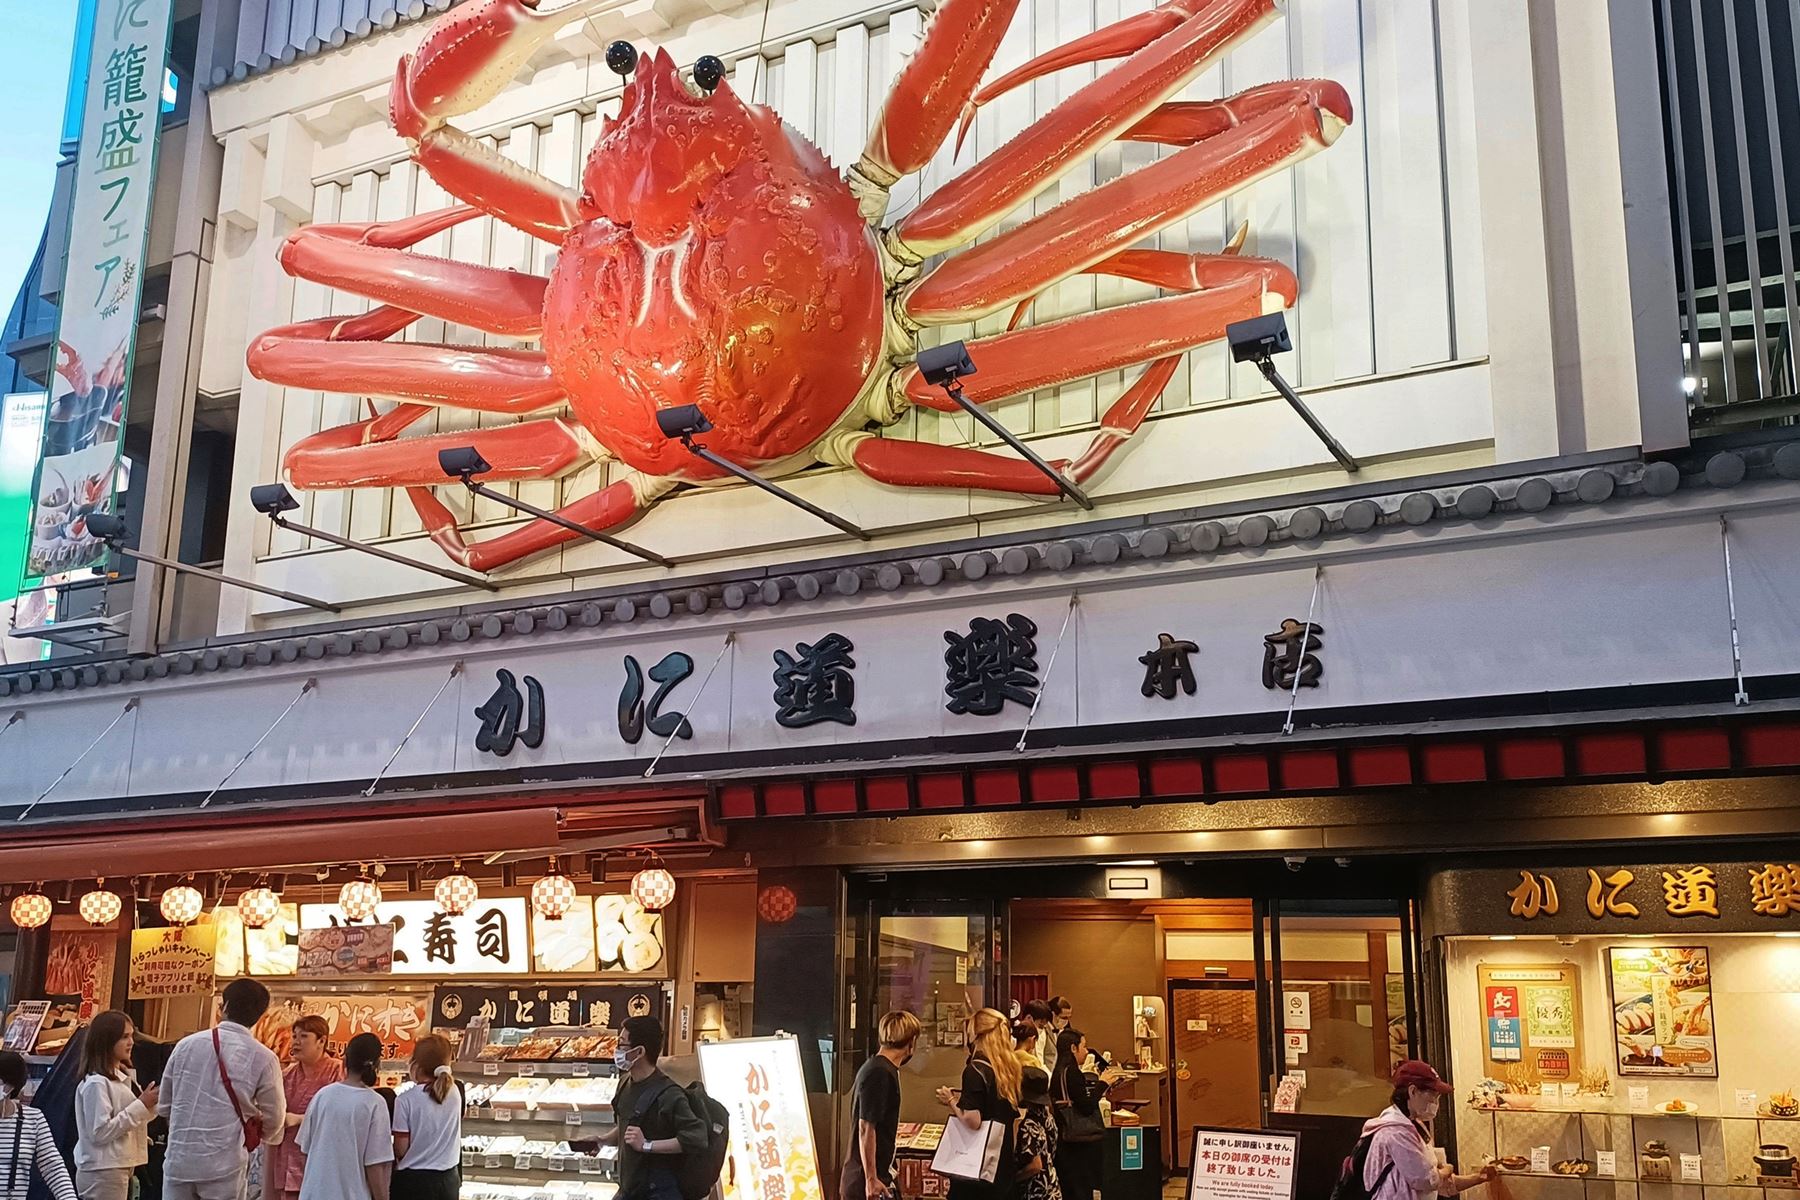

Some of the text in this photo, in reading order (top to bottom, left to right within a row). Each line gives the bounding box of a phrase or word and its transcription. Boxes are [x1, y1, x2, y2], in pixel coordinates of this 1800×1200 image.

[131, 943, 213, 966] いらっしゃいキャンペーン
[137, 959, 206, 971] ご利用可能なクーポン
[321, 999, 422, 1041] かにすき
[1202, 1150, 1291, 1166] 本日の御席の受付は
[1206, 1163, 1281, 1179] 終了致しました。
